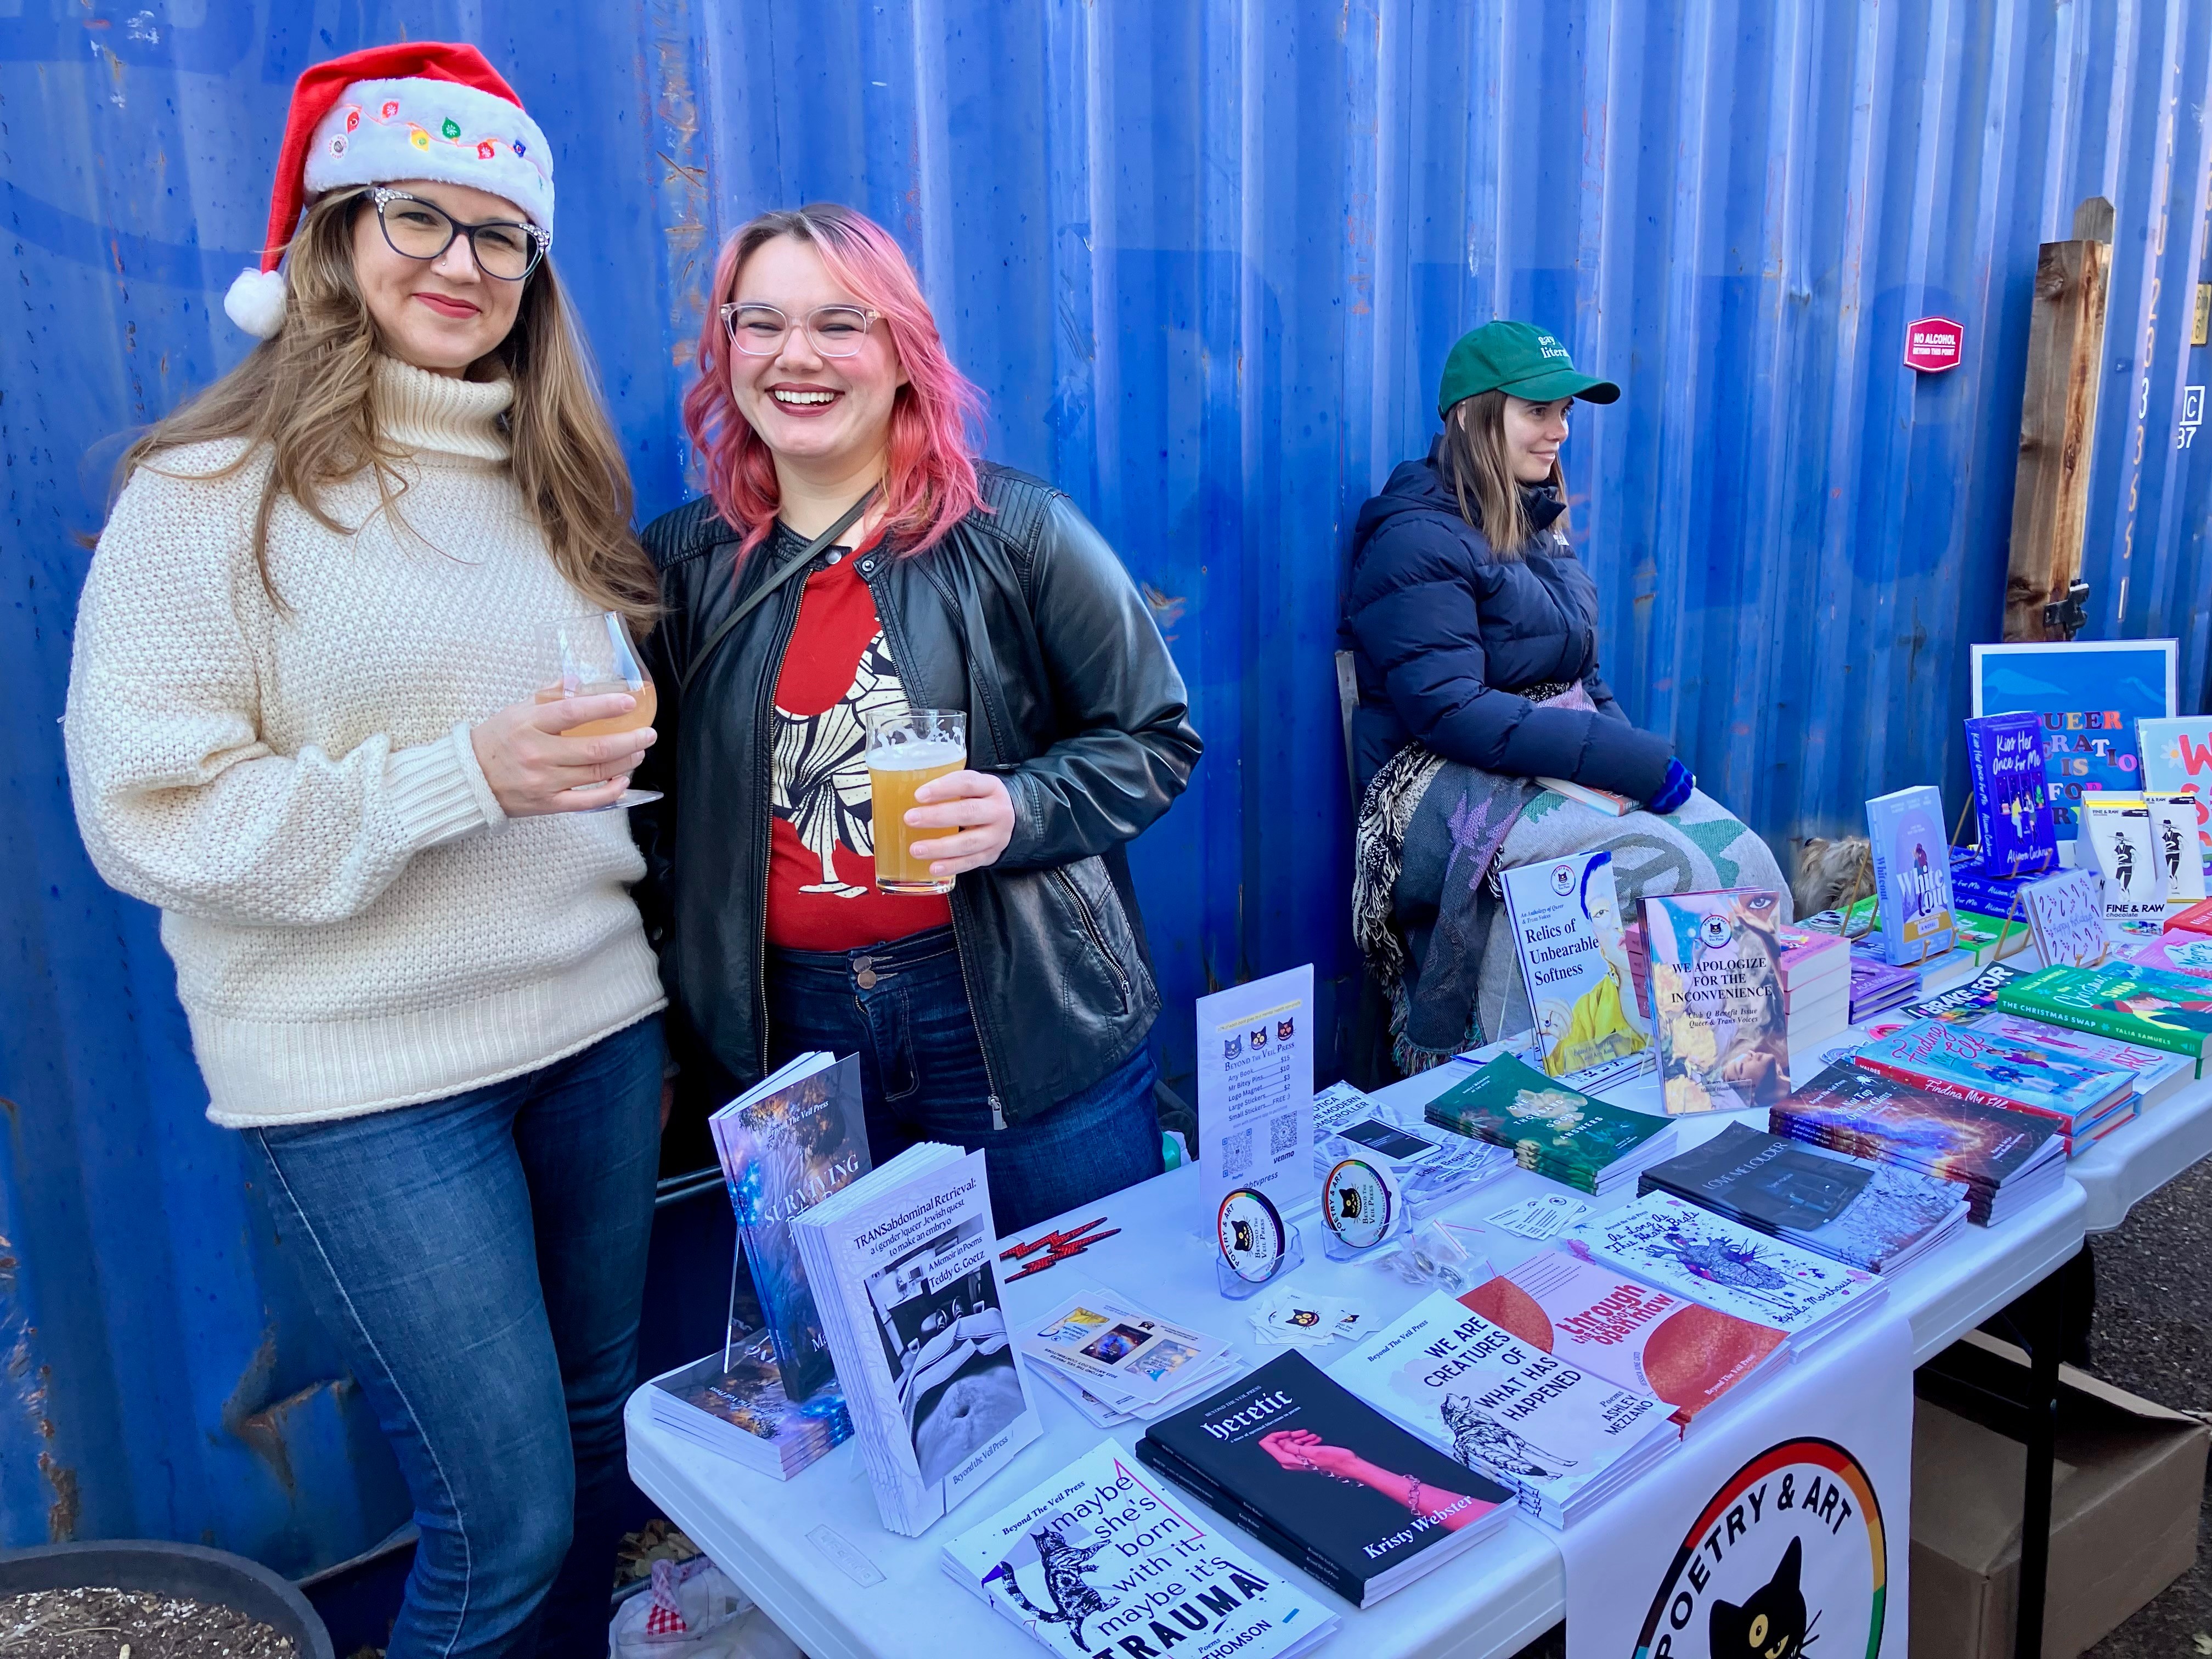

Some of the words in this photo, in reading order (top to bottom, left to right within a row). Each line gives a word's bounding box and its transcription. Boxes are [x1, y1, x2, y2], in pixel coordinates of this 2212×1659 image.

[1538, 336, 1556, 345] gay
[1914, 333, 1924, 343] NO
[1925, 334, 1955, 345] ALCOHOL
[2041, 711, 2123, 730] UEER
[1996, 735, 2016, 757] Kiss
[2018, 730, 2033, 753] Her
[1993, 757, 2013, 775] Once
[2015, 757, 2025, 772] for
[2027, 749, 2041, 770] Me
[2061, 758, 2089, 776] IS
[1897, 865, 1944, 896] White
[1923, 884, 1948, 910] out
[2106, 904, 2129, 912] FINE
[2131, 904, 2140, 912] &
[2141, 904, 2165, 912] RAW
[1525, 924, 1561, 944] Relics
[1564, 918, 1576, 933] of
[1530, 936, 1599, 964] Unbearable
[1534, 964, 1583, 986] Softness
[1672, 963, 1691, 973] WE
[1695, 958, 1767, 972] APOLOGIZE
[1694, 975, 1718, 986] FOR
[1721, 974, 1746, 984] THE
[1920, 989, 1978, 1014] BRAKE
[1971, 966, 2014, 992] FOR
[2100, 981, 2138, 998] SWAP
[1672, 986, 1772, 1003] INCONVENIENCE
[2002, 1000, 2018, 1009] THE
[2020, 1004, 2069, 1022] CHRISTMAS
[2071, 1016, 2096, 1028] SWAP
[2115, 1028, 2135, 1036] TALIA
[2138, 1032, 2171, 1045] SAMUELS
[1228, 1074, 1239, 1082] Any
[1240, 1068, 1253, 1077] Book
[1237, 1079, 1251, 1089] Bitey
[1252, 1075, 1263, 1083] Pins
[1280, 1064, 1290, 1073] $10
[1228, 1093, 1242, 1102] Logo
[1243, 1085, 1262, 1096] Magnet
[1228, 1102, 1244, 1111] Large
[1244, 1093, 1266, 1105] Stickers
[1313, 1097, 1340, 1111] OTICA
[1508, 1098, 1529, 1111] ONE
[1831, 1105, 1847, 1114] Do
[1842, 1093, 1861, 1108] Not
[1858, 1089, 1875, 1099] Tap
[1925, 1079, 1962, 1099] Finding
[1965, 1090, 1984, 1104] My
[1228, 1110, 1244, 1121] Small
[1244, 1103, 1266, 1115] Stickers
[1272, 1094, 1286, 1105] FREE
[1313, 1113, 1325, 1121] HE
[1322, 1095, 1362, 1115] MODERN
[1313, 1102, 1369, 1128] OMSCROLLER
[1513, 1099, 1564, 1126] THOUSAND
[1846, 1111, 1861, 1120] On
[1857, 1103, 1875, 1114] The
[1869, 1092, 1893, 1105] Glass
[1545, 1113, 1574, 1128] GOOD
[1559, 1116, 1604, 1141] ANSWERS
[1273, 1150, 1295, 1164] venmo
[1415, 1165, 1443, 1177] Eddie
[1440, 1150, 1474, 1166] Brophy
[1702, 1173, 1736, 1190] LOVE
[1728, 1165, 1751, 1178] ME
[1745, 1142, 1788, 1170] LOUDER
[764, 1154, 860, 1228] SURVIVING
[854, 1198, 934, 1249] TRANSabdominal
[935, 1178, 977, 1206] Retrieval:
[1224, 1203, 1234, 1220] ART
[875, 1221, 922, 1255] (gender)queer
[923, 1209, 947, 1227] Jewish
[946, 1199, 965, 1218] quest
[889, 1246, 898, 1256] to
[898, 1238, 916, 1253] make
[916, 1233, 926, 1243] an
[925, 1218, 952, 1241] embryo
[1604, 1241, 1638, 1253] This
[1634, 1223, 1670, 1242] Heart
[1666, 1211, 1700, 1227] Beats
[934, 1250, 956, 1269] Memoir
[956, 1248, 963, 1256] in
[963, 1236, 983, 1253] Poems
[1222, 1230, 1240, 1267] POETRY
[929, 1271, 953, 1289] Teddy
[953, 1262, 963, 1274] G.
[962, 1250, 985, 1269] Goetz
[1555, 1284, 1647, 1335] through
[1593, 1319, 1641, 1345] open
[1629, 1293, 1674, 1323] maw
[1367, 1346, 1391, 1363] Beyond
[1388, 1337, 1402, 1348] The
[1400, 1329, 1414, 1340] Veil
[1412, 1319, 1429, 1332] Press
[1424, 1338, 1458, 1358] WE
[1453, 1316, 1489, 1342] ARE
[1571, 1331, 1595, 1344] the
[1589, 1322, 1611, 1335] red
[1424, 1330, 1510, 1387] CREATURES
[1501, 1347, 1527, 1365] OF
[1475, 1376, 1527, 1409] WHAT
[1520, 1357, 1559, 1380] HAS
[1501, 1370, 1582, 1421] HAPPENED
[1599, 1390, 1624, 1408] Poems
[1601, 1395, 1639, 1422] ASHLEY
[1200, 1390, 1293, 1441] heretic
[1604, 1400, 1654, 1436] MEZZANO
[953, 1464, 975, 1485] Beyond
[972, 1457, 984, 1471] the
[981, 1447, 994, 1460] Veil
[991, 1436, 1008, 1451] Press
[1002, 1514, 1032, 1535] Beyond
[1031, 1505, 1048, 1517] The
[1047, 1493, 1065, 1506] Veil
[1064, 1481, 1086, 1497] Press
[1051, 1477, 1133, 1532] maybe
[1094, 1495, 1157, 1539] she's
[1115, 1517, 1182, 1558] born
[1363, 1530, 1414, 1559] Kristy
[1410, 1496, 1472, 1532] Webster
[1111, 1555, 1173, 1593] with
[1174, 1536, 1207, 1561] it,
[1655, 1483, 1767, 1659] POETRY
[1777, 1473, 1795, 1511] &
[1802, 1476, 1852, 1535] ART
[1097, 1582, 1186, 1637] maybe
[1185, 1554, 1228, 1582] it's
[1198, 1638, 1221, 1654] Poems
